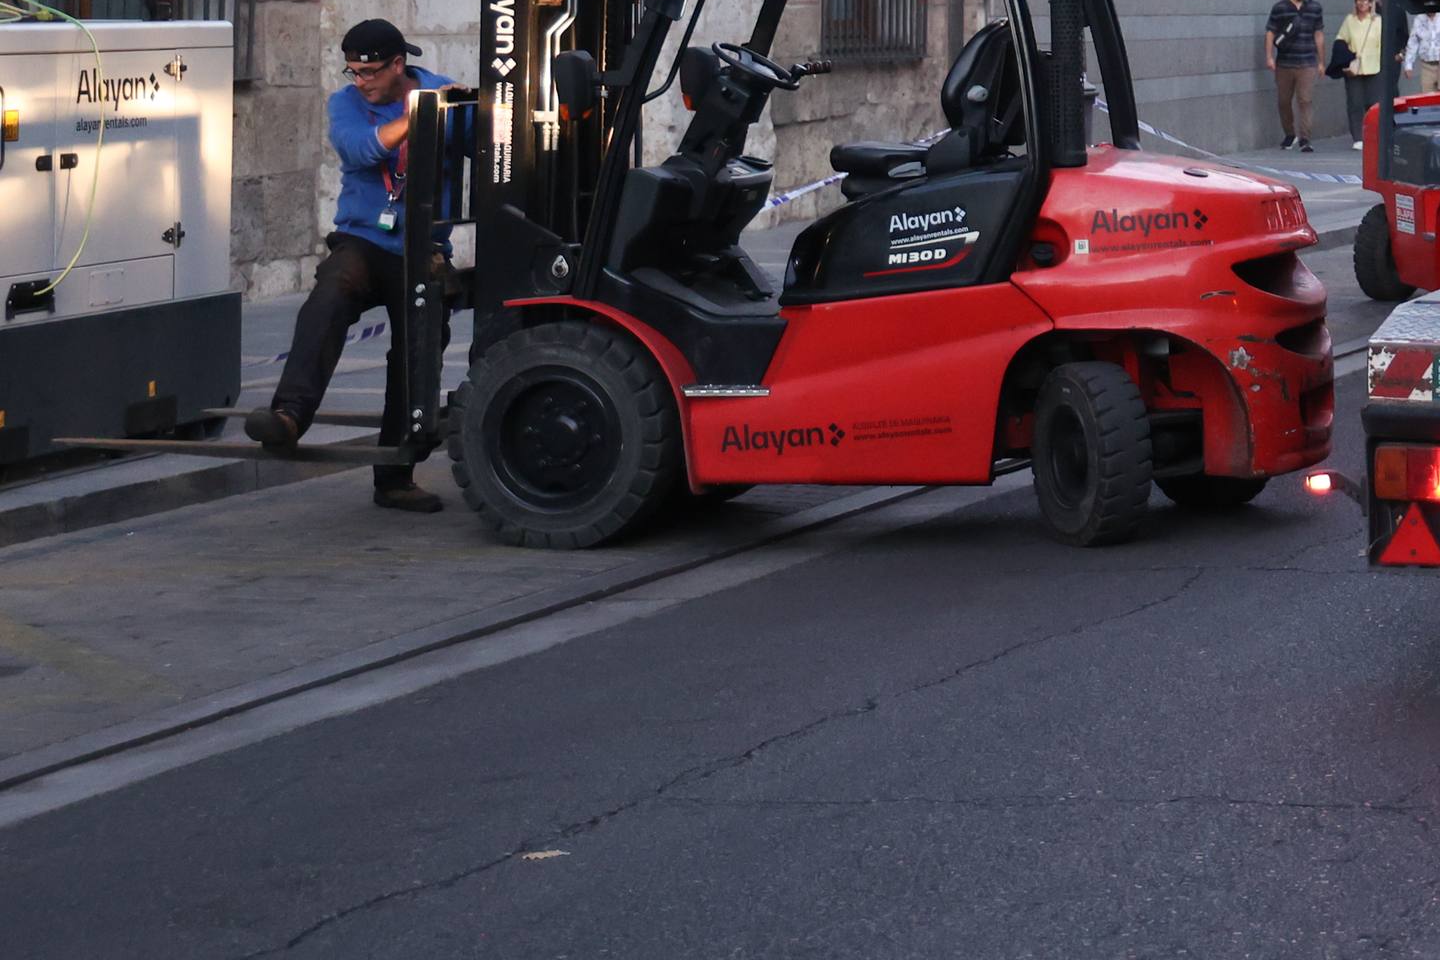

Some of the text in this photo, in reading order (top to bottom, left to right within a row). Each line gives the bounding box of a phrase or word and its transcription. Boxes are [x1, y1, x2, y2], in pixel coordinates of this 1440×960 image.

[76, 68, 146, 111] Alayan
[889, 210, 953, 232] Alayan
[1091, 208, 1189, 237] Alayan
[890, 226, 969, 246] www.alayanrentals.com
[721, 424, 825, 455] Alayan
